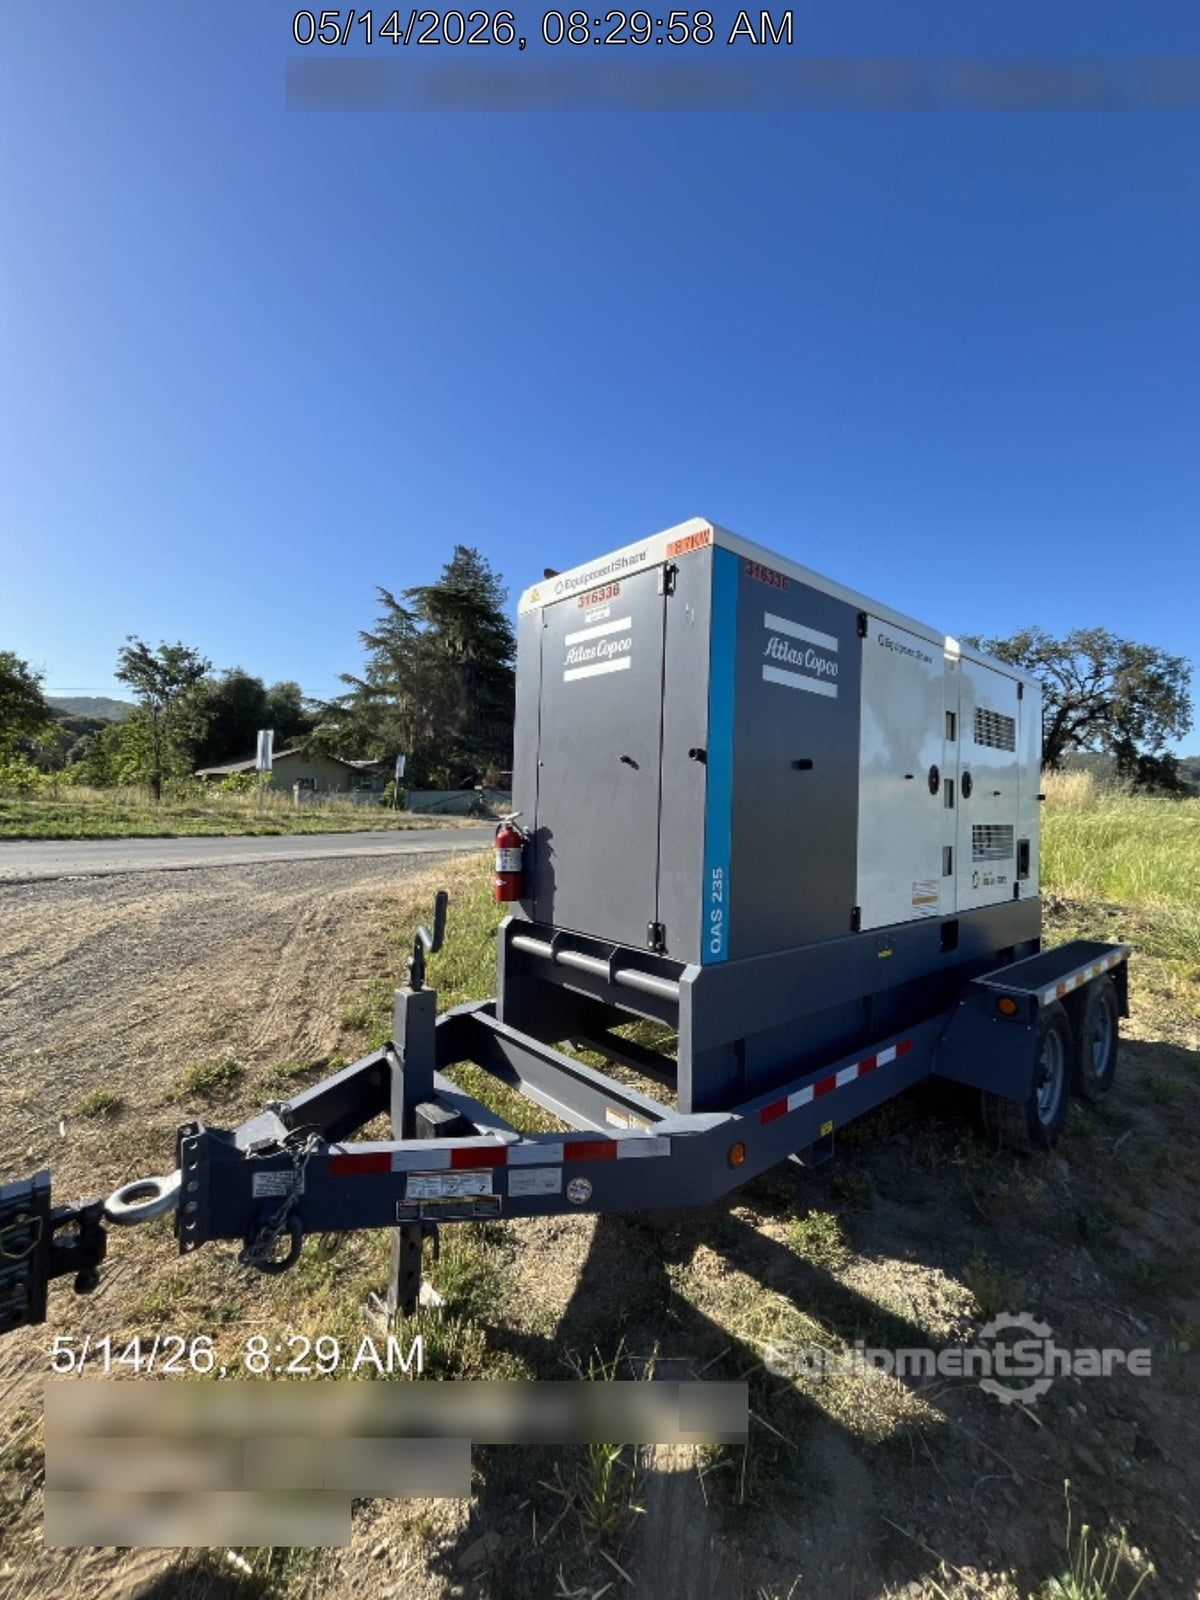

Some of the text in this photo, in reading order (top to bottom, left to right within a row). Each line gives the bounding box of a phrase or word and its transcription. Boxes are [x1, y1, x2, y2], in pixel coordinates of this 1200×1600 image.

[577, 583, 621, 609] 316336
[564, 638, 632, 666] Atlas Copco
[762, 637, 839, 676] Atlas Copco
[711, 867, 723, 903] 235
